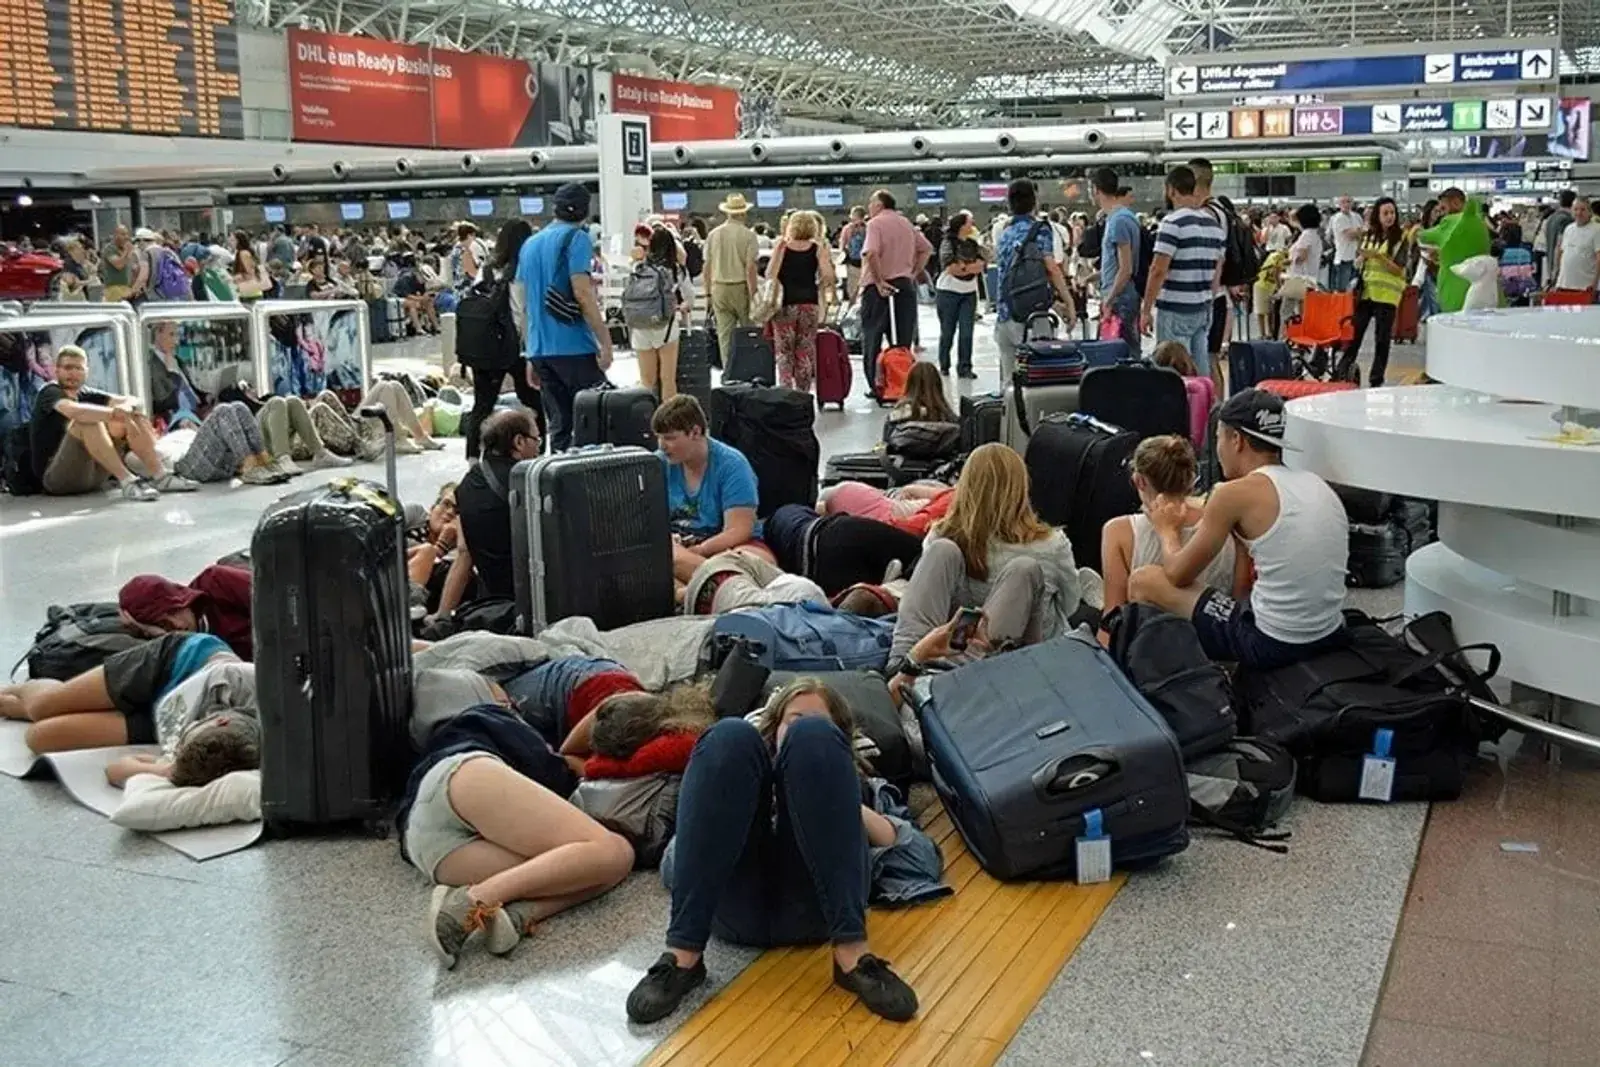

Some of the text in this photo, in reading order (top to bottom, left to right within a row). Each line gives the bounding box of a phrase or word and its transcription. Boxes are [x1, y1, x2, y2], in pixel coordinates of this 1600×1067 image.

[297, 42, 453, 79] DHL è un Ready Business
[1460, 52, 1519, 67] Imbarchi
[1233, 63, 1287, 79] doganali
[659, 90, 682, 108] Ready
[683, 93, 714, 110] Business
[1405, 105, 1442, 118] Arrivi
